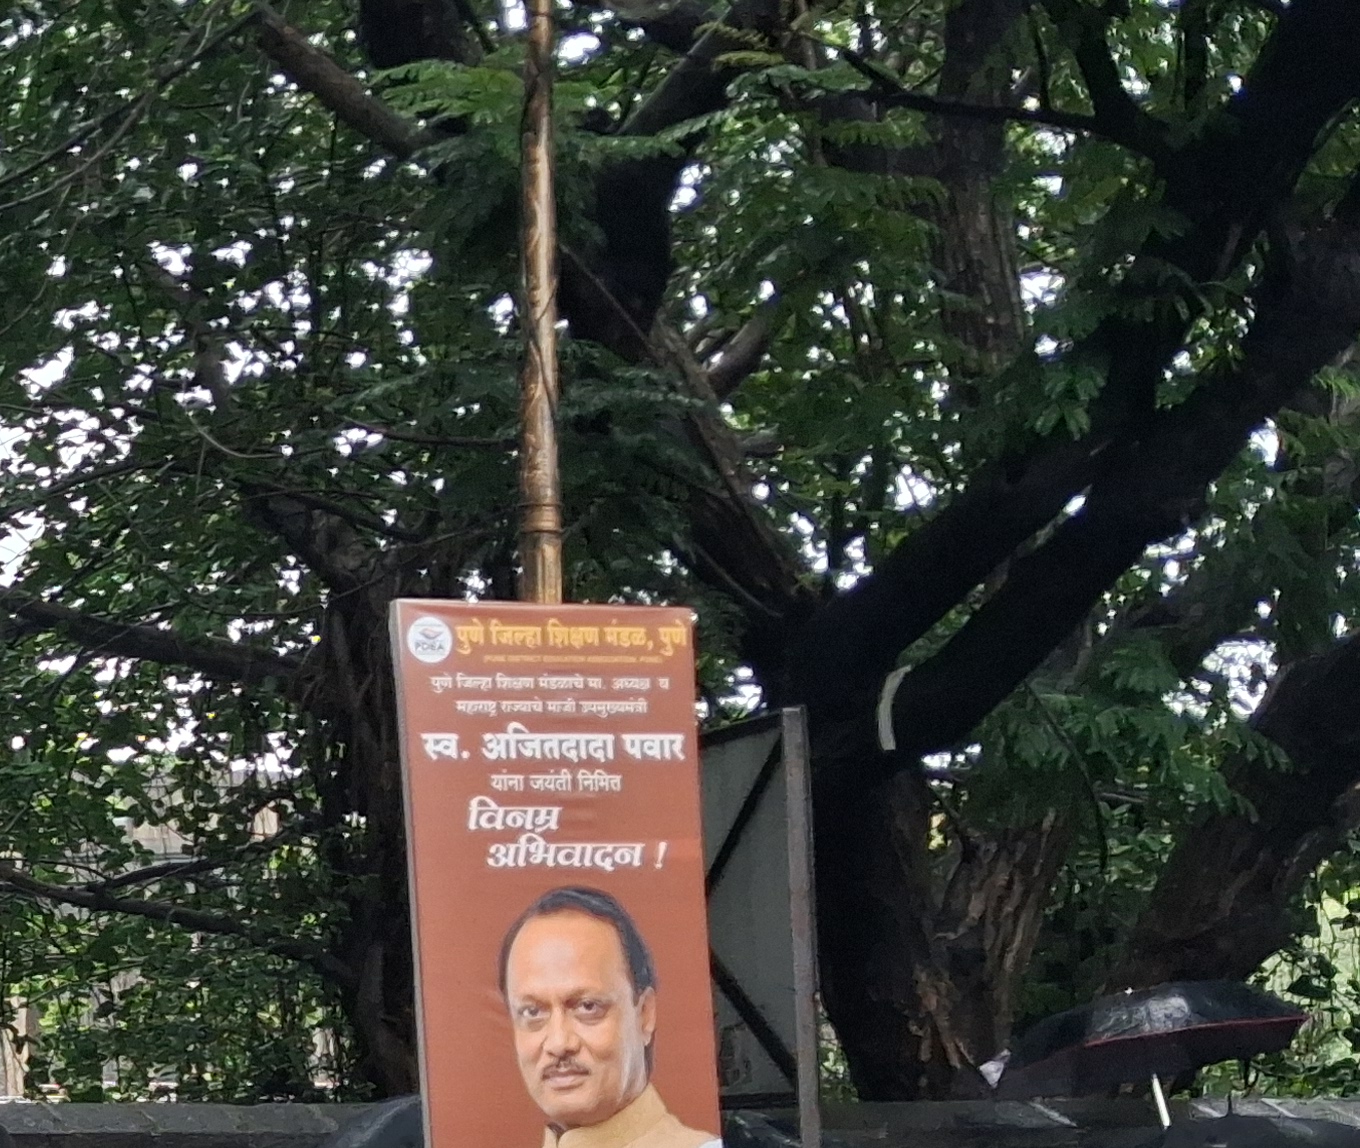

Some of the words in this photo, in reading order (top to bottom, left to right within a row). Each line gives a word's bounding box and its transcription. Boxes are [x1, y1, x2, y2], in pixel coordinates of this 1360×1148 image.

[455, 618, 484, 655] पुणे
[490, 619, 542, 648] जिल्हा
[547, 618, 599, 647] शिक्षण
[658, 620, 688, 656] पुणे
[421, 732, 470, 761] स्व.
[482, 722, 615, 763] अजितदादा
[622, 732, 685, 762] पवार
[529, 768, 572, 792] जयंती
[467, 796, 561, 833] विनम्र
[487, 833, 645, 871] अभिवादन
